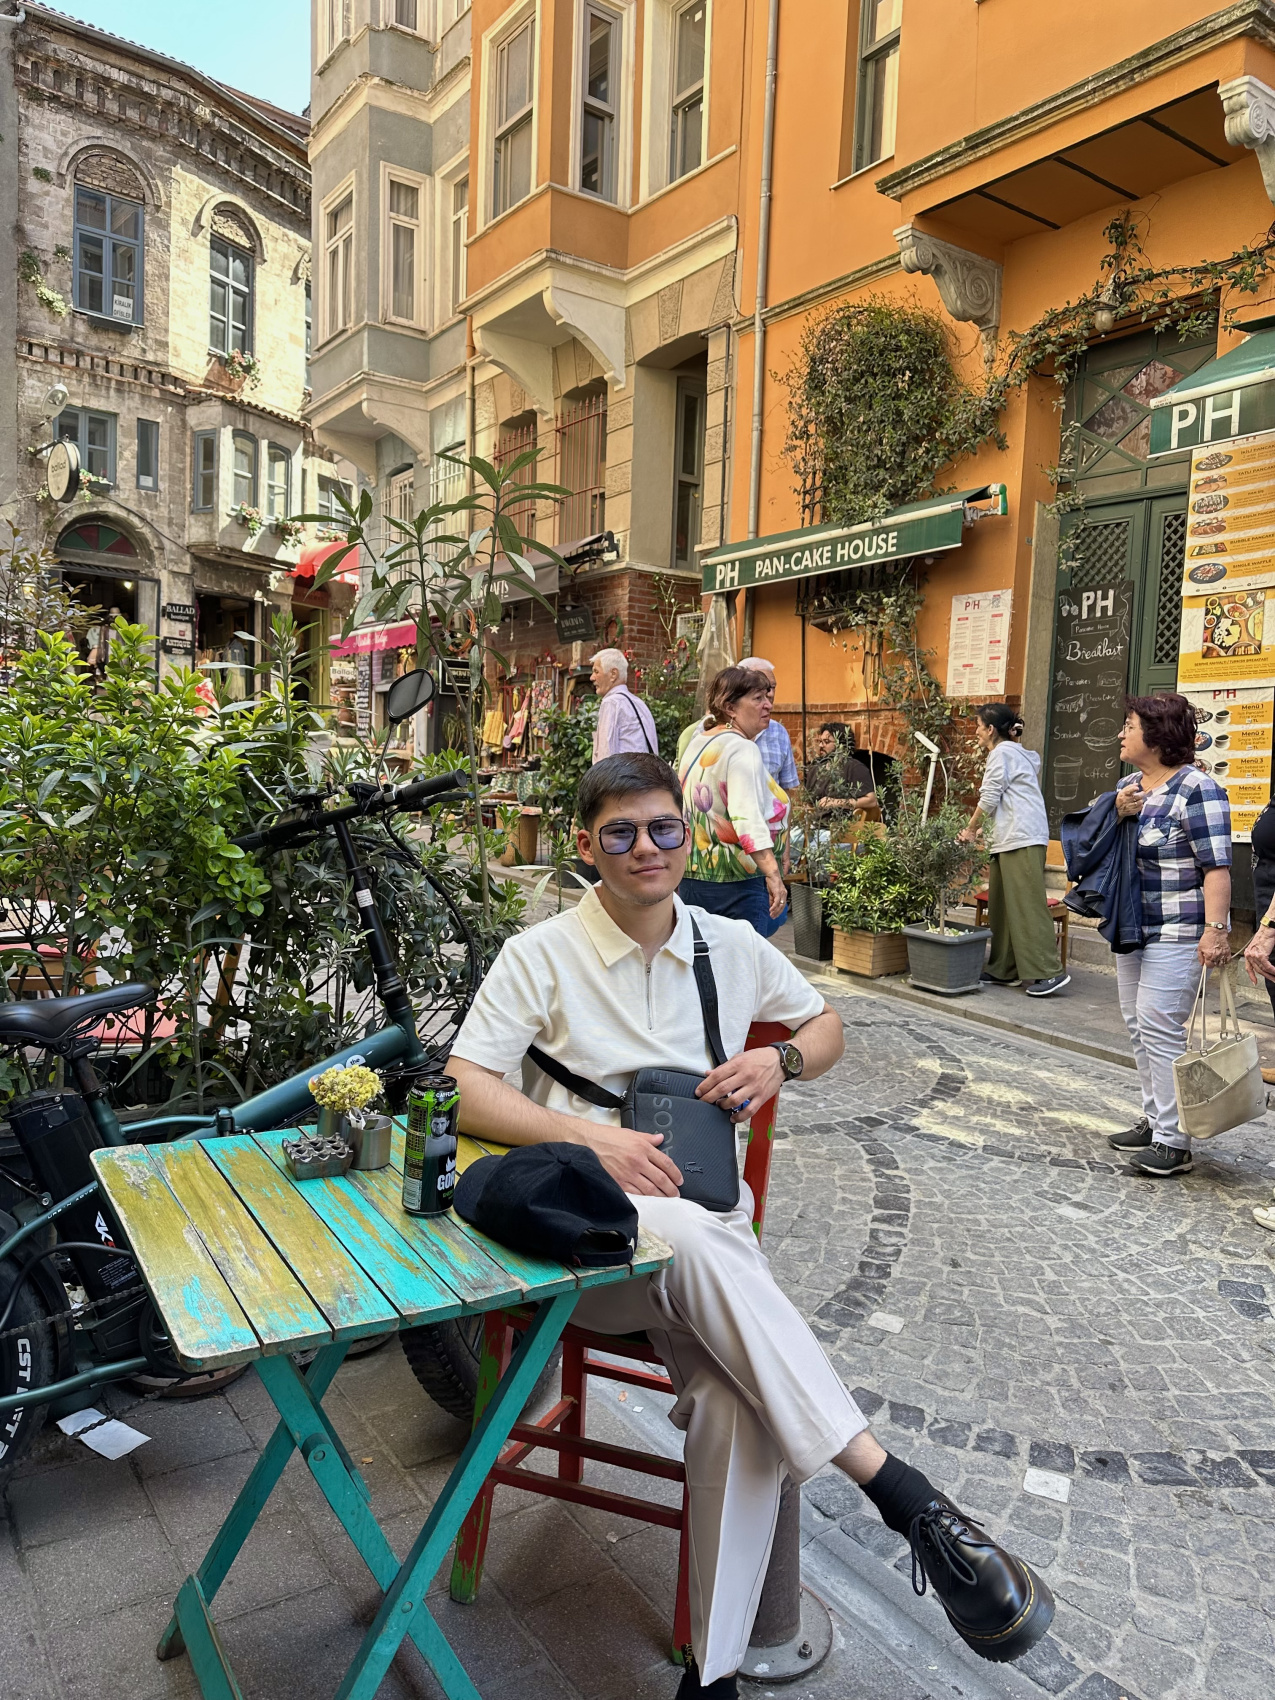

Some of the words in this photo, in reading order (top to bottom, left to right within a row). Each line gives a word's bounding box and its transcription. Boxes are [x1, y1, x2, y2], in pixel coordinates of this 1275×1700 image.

[755, 545, 832, 579] PAN-CAKE
[836, 531, 898, 563] HOUSE
[167, 604, 195, 614] BALLAD
[1081, 588, 1115, 620] PH
[1066, 637, 1124, 661] Breakfast
[17, 1338, 32, 1382] CST
